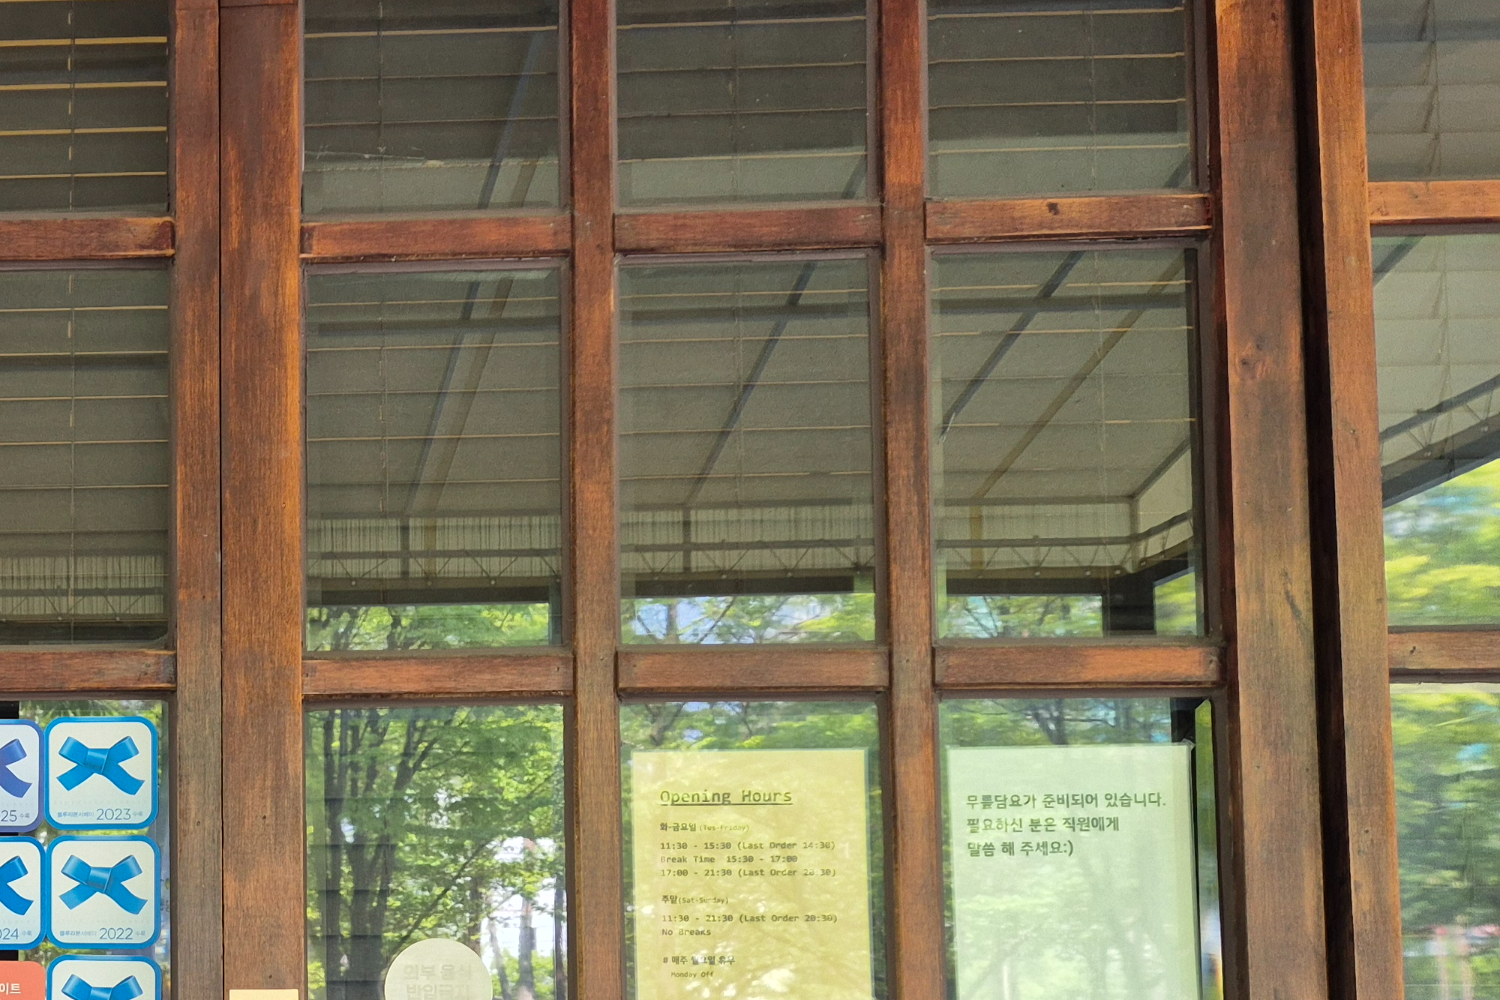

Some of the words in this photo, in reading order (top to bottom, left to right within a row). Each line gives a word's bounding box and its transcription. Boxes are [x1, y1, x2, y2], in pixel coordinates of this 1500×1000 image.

[660, 790, 731, 804] Opening
[742, 790, 791, 802] Hours
[1042, 794, 1098, 808] 준비되어
[1105, 792, 1166, 807] 있습니다.
[97, 809, 131, 820] 2023
[967, 818, 1023, 833] 필요하신
[1029, 818, 1056, 832] 분은
[1063, 817, 1119, 832] 직원에게
[968, 843, 995, 857] 말씀
[1001, 842, 1014, 856] 해
[770, 855, 798, 863] 17:00
[100, 928, 133, 940] 2022
